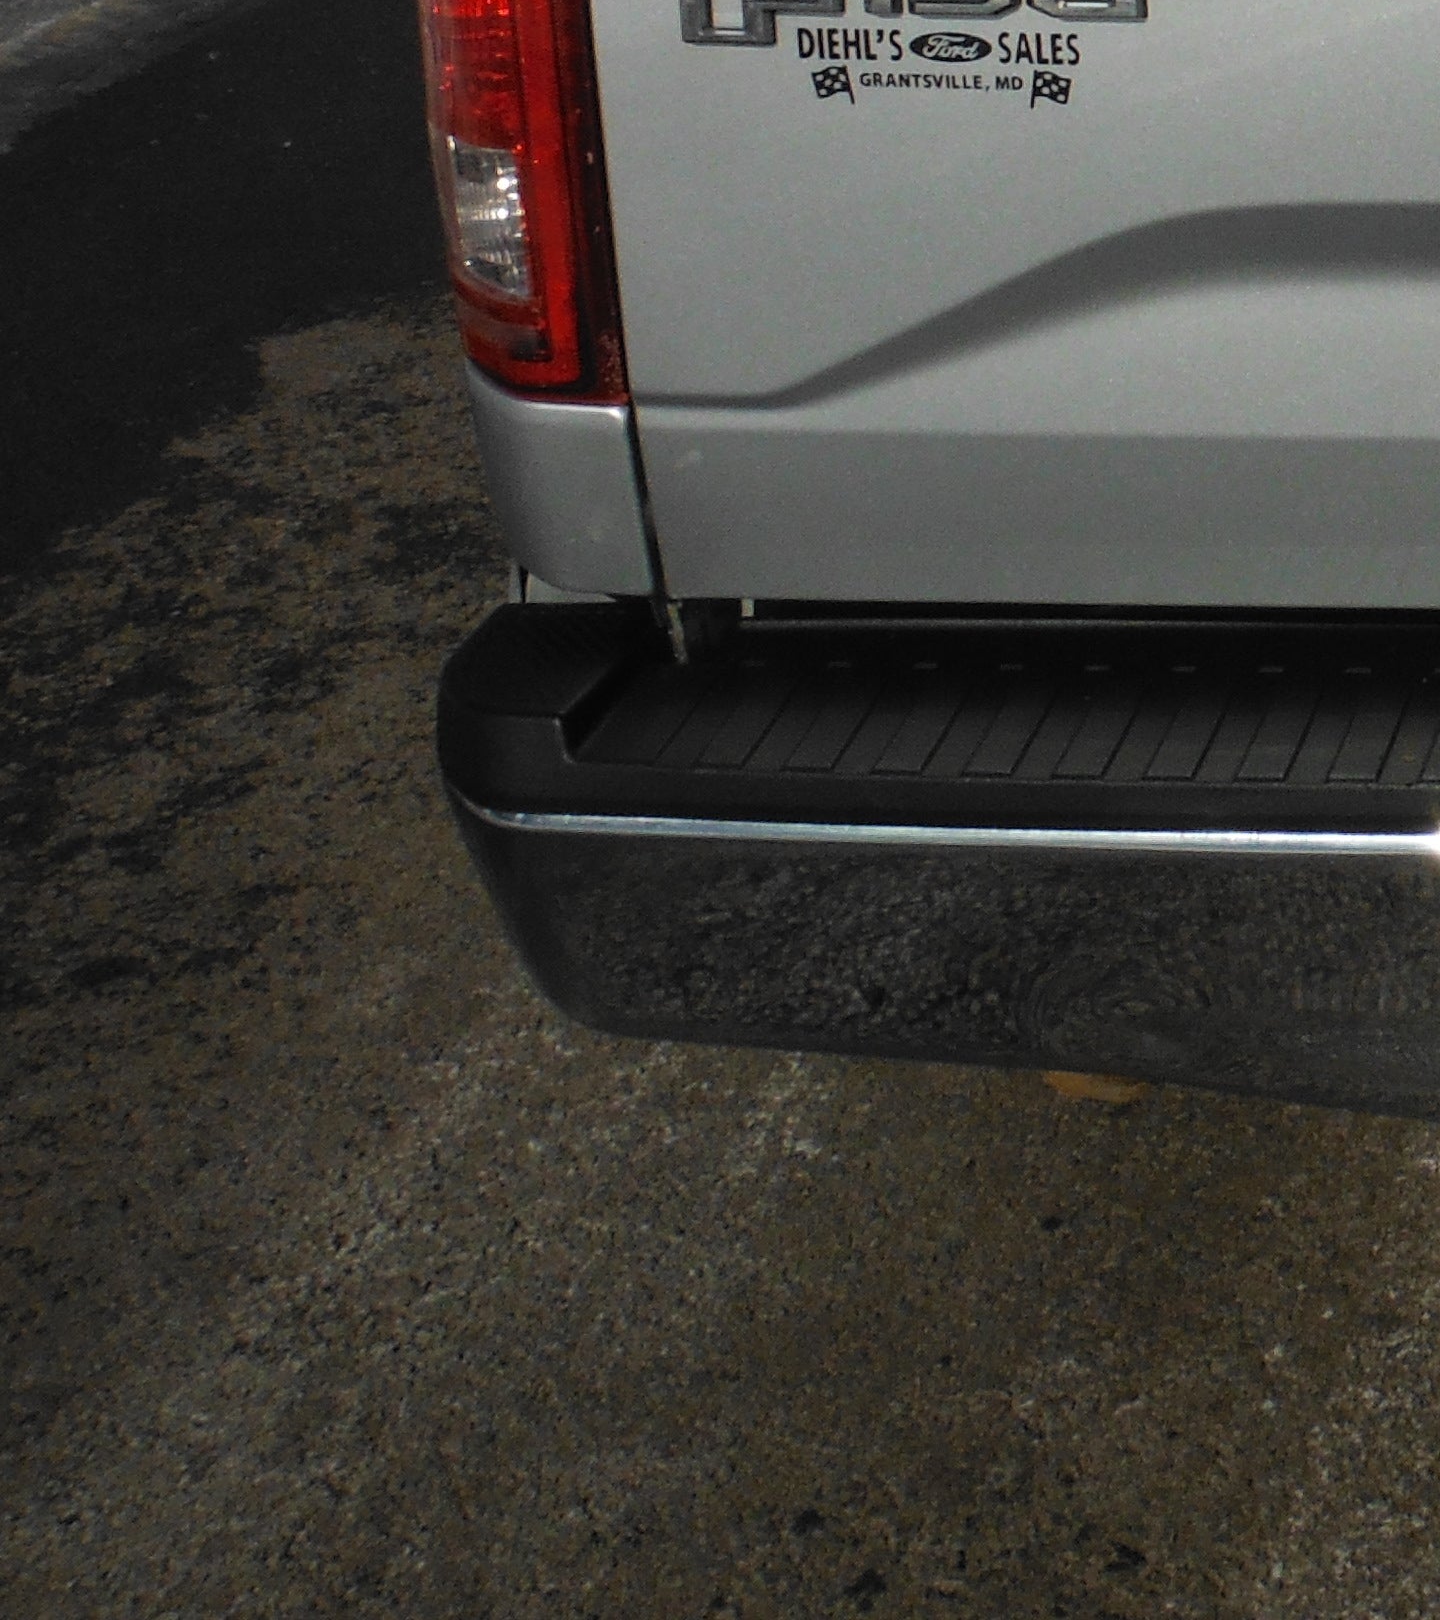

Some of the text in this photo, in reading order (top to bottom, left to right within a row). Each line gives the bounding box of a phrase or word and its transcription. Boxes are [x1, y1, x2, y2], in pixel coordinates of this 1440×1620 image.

[797, 28, 1080, 65] DIEHL'S Ford SALES
[860, 73, 1023, 91] GRANTSVILLE, MD
